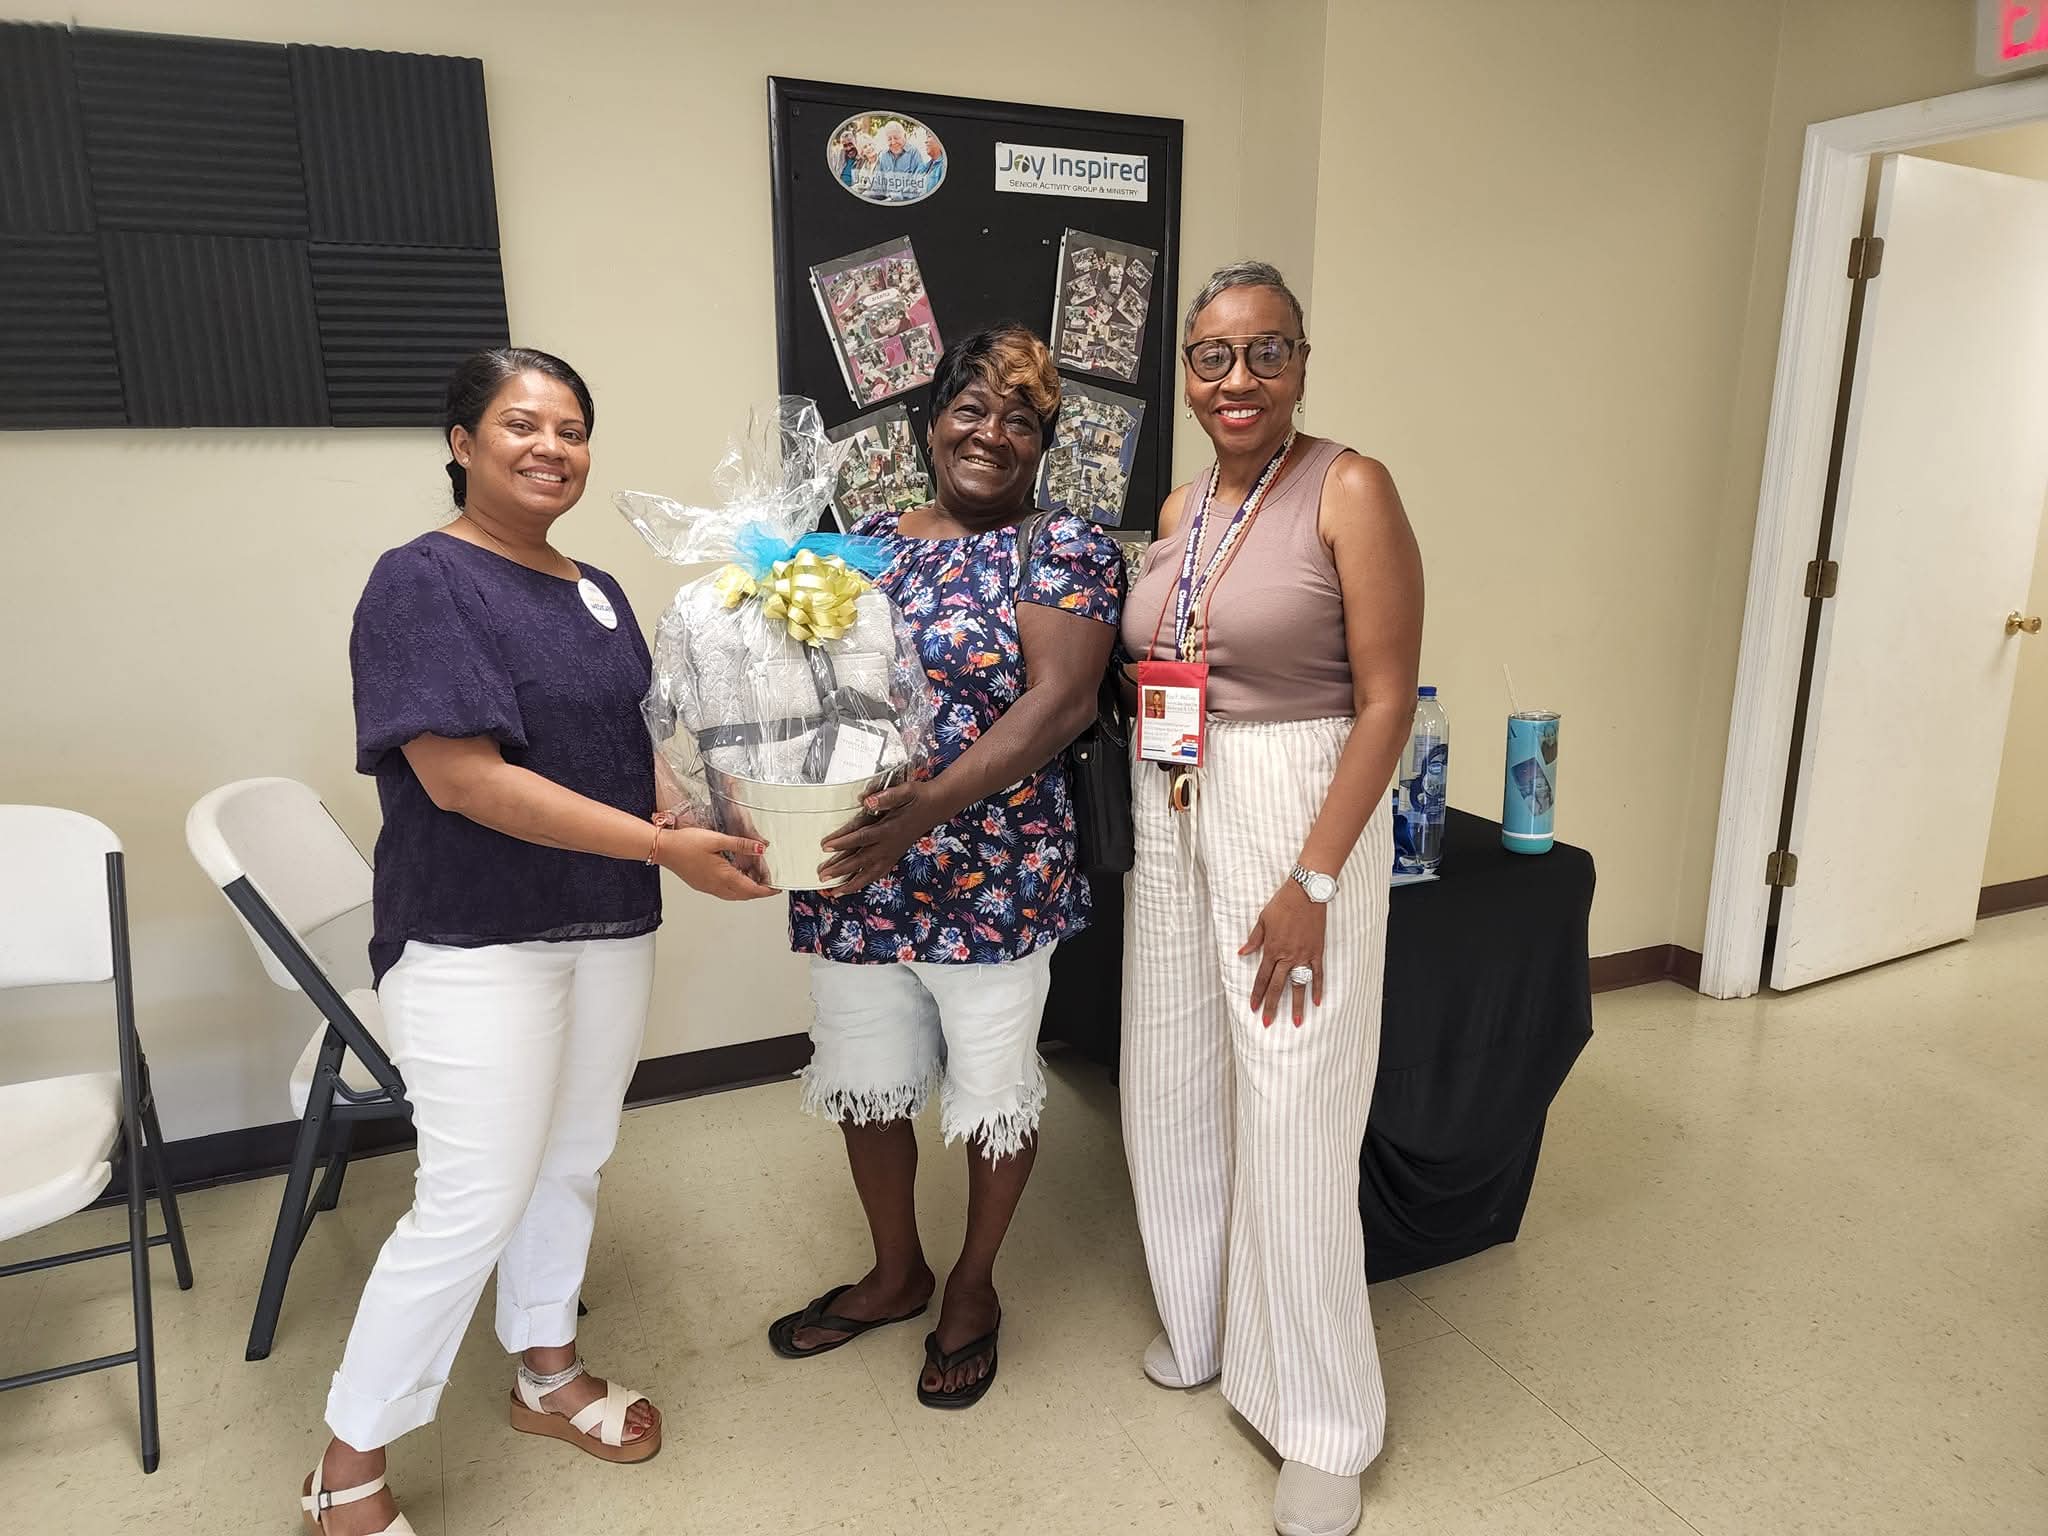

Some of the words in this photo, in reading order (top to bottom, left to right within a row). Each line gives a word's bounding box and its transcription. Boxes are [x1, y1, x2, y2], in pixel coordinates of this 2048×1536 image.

[1000, 149, 1045, 180] Joy
[1053, 153, 1146, 184] Inspired
[877, 175, 925, 190] Inspired
[1176, 589, 1188, 618] Clover
